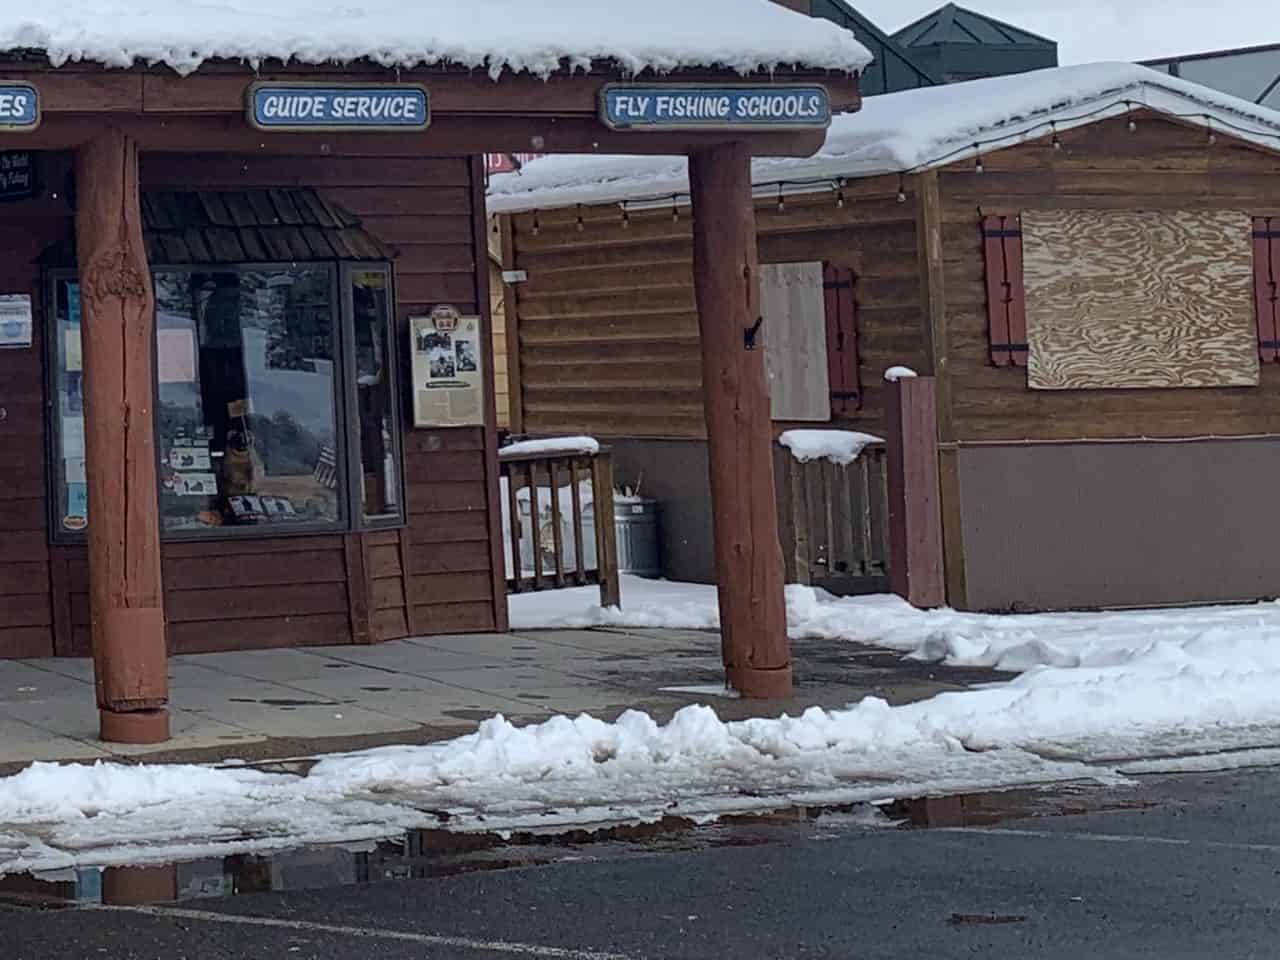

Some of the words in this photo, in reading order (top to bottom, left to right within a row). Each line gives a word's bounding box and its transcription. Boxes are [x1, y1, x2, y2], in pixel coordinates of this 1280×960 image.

[263, 96, 327, 118] GUIDE
[331, 96, 418, 118] SERVICE
[615, 96, 649, 117] FLY
[656, 96, 730, 117] FISHING
[736, 95, 820, 117] SCHOOLS
